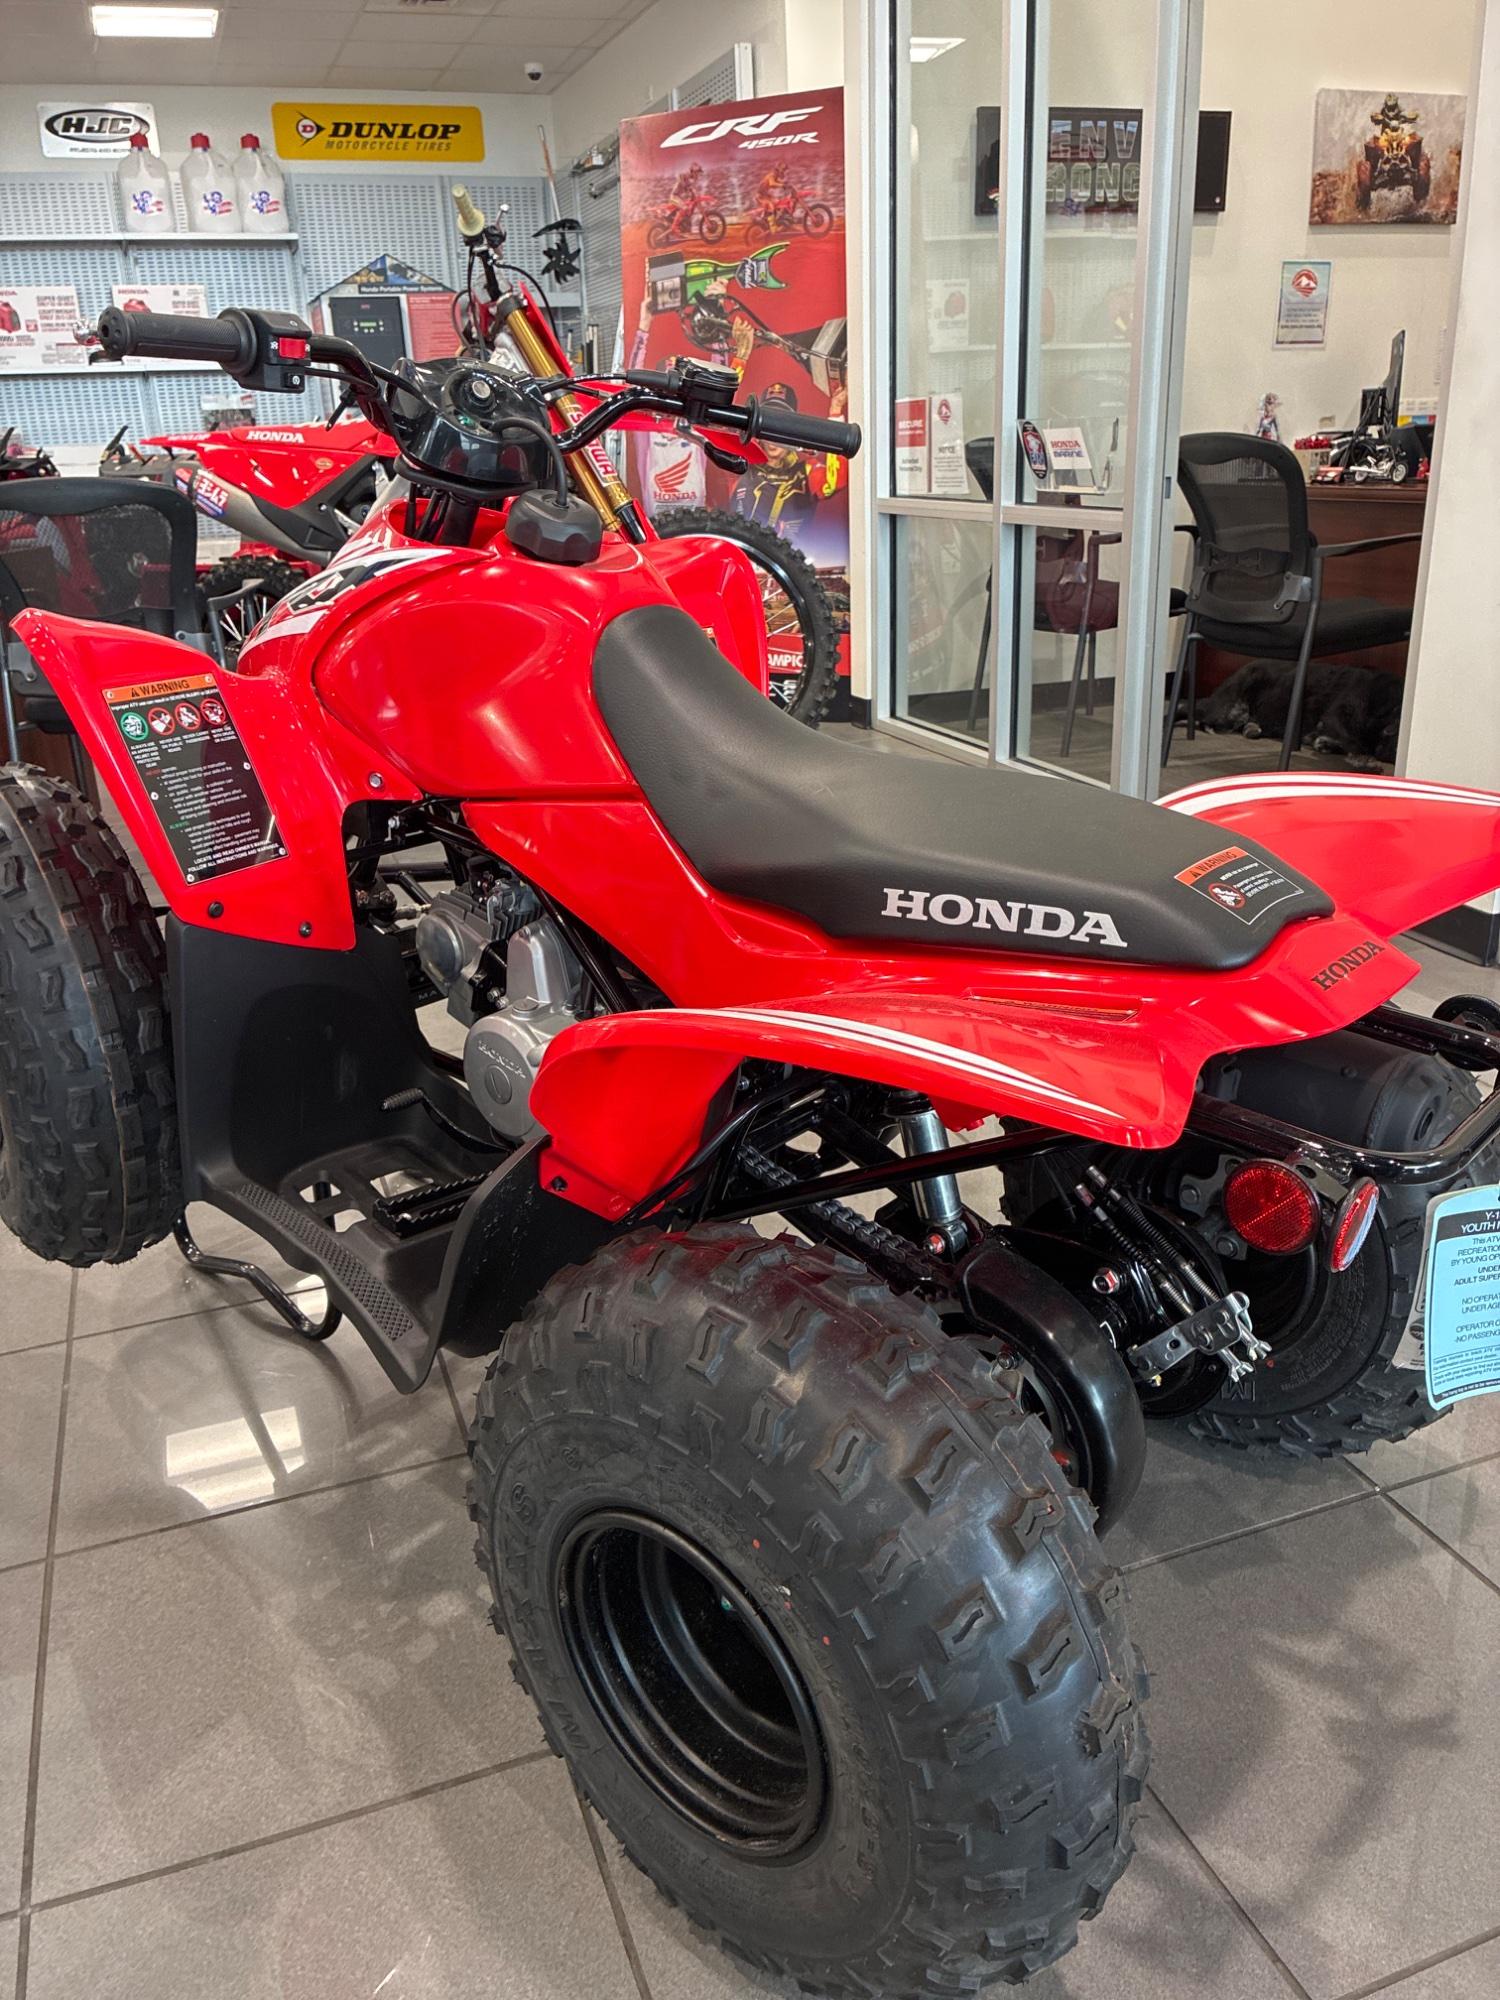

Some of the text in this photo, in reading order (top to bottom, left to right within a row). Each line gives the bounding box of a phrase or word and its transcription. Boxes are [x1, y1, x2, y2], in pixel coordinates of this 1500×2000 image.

[61, 117, 133, 135] HJC
[328, 122, 461, 139] DUNLOP
[660, 106, 824, 148] CRF
[324, 140, 452, 151] MOTORCYCLE TIRES
[738, 132, 819, 149] 450R
[1050, 120, 1139, 159] ENV
[1047, 162, 1140, 202] RONG
[246, 431, 305, 443] HONDA
[1050, 440, 1082, 449] HONDA
[654, 490, 697, 500] HONDA
[140, 680, 190, 696] WARNING
[1197, 851, 1237, 872] WARNING
[882, 887, 1128, 947] HONDA
[1311, 941, 1385, 991] HONDA
[1485, 1211, 1500, 1221] Y-1
[1461, 1221, 1496, 1233] YOUTH
[1473, 1237, 1486, 1245] This
[1457, 1244, 1500, 1256] RECREATIO
[1462, 1255, 1488, 1264] YOUNG
[1454, 1276, 1478, 1286] ADULT
[1462, 1292, 1500, 1305] NO OPERA
[1462, 1304, 1487, 1314] UNDER
[1456, 1320, 1495, 1333] OPERATOR
[1468, 1329, 1500, 1340] PASSENG
